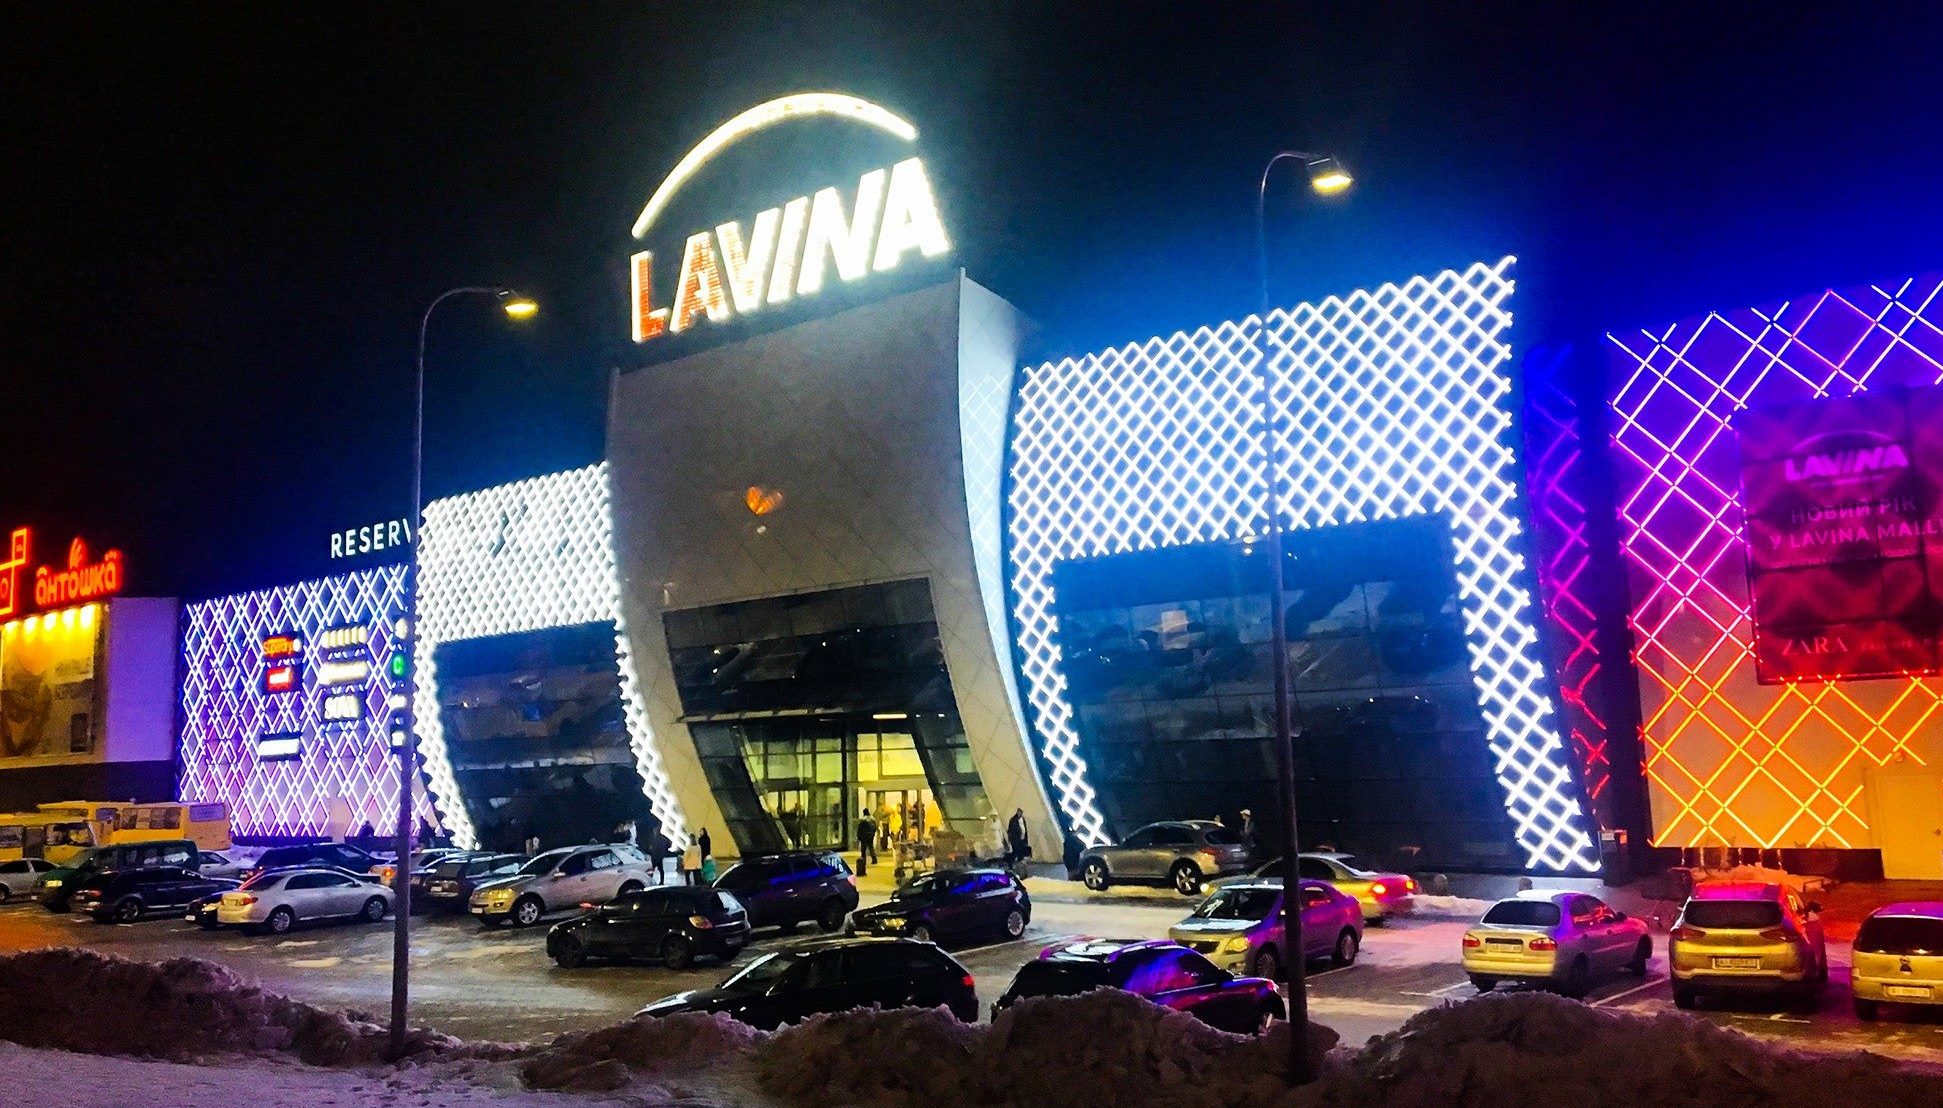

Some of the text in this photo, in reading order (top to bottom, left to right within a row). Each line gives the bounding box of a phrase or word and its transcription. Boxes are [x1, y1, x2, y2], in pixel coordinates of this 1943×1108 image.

[630, 156, 951, 343] LAVINA
[1785, 444, 1909, 482] LAVINA
[1791, 496, 1916, 524] НОВИЙ РІК
[1790, 526, 1869, 548] LAVINA
[1782, 637, 1848, 656] ZARA
